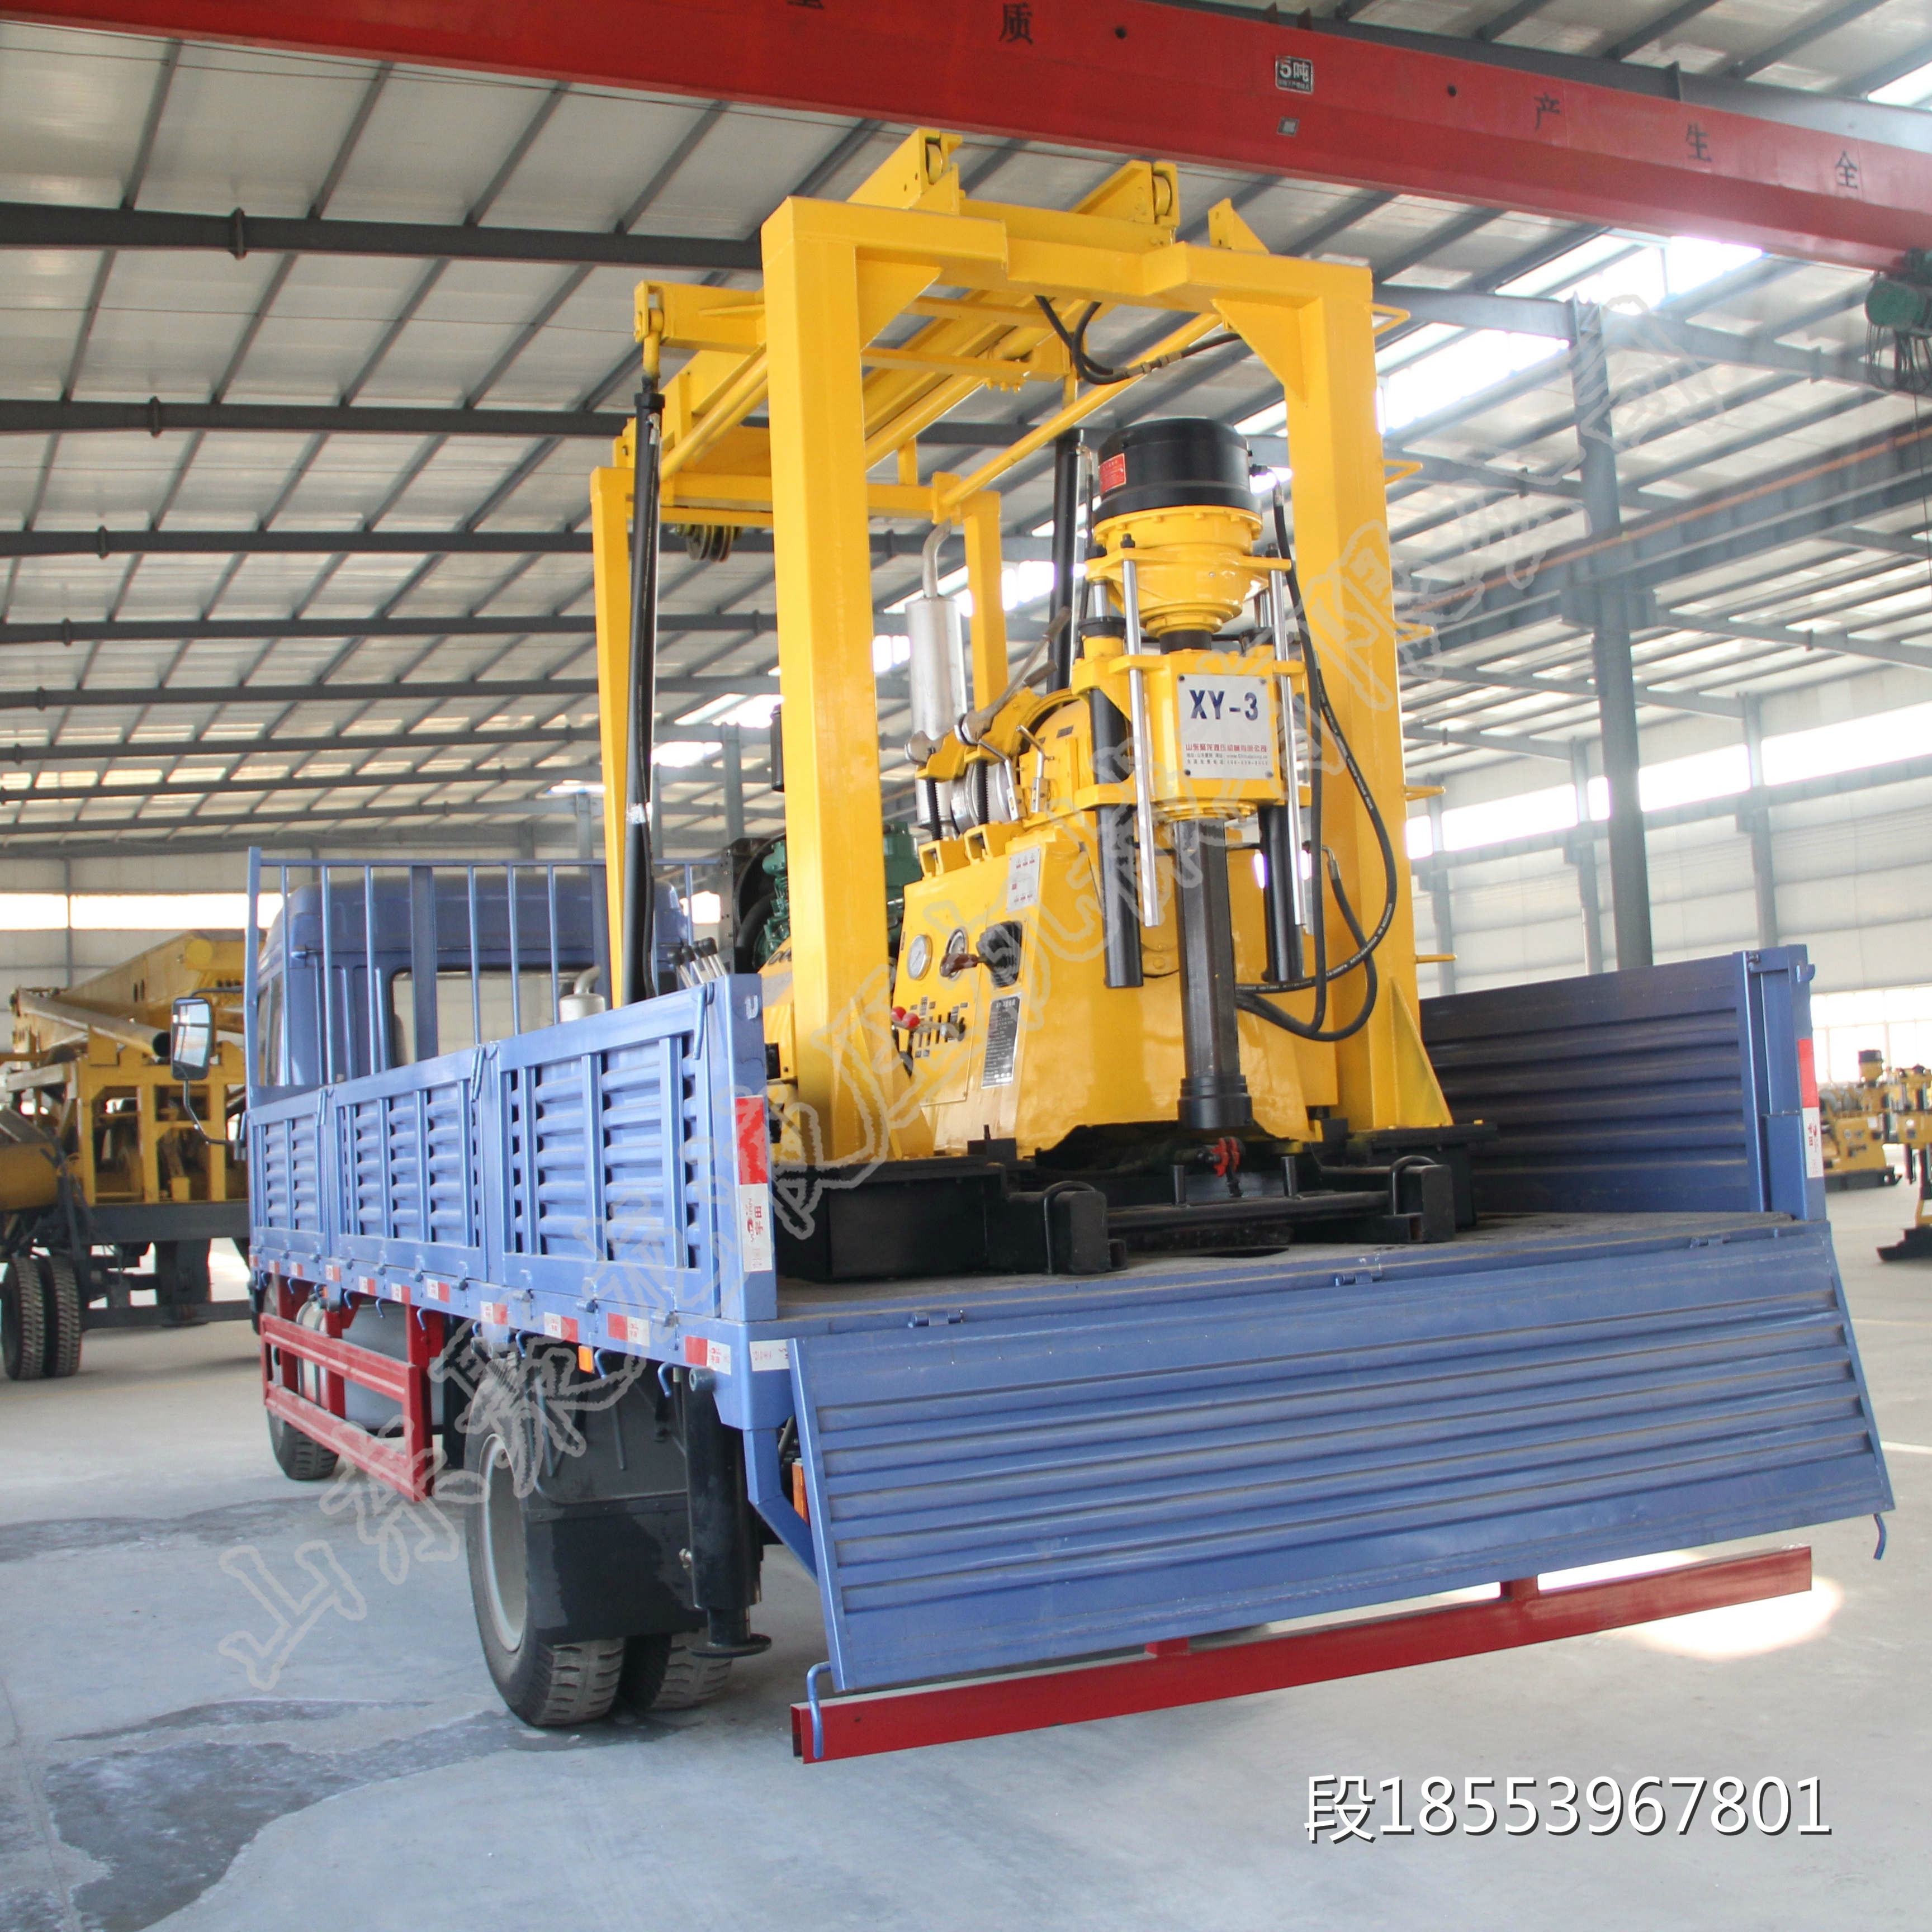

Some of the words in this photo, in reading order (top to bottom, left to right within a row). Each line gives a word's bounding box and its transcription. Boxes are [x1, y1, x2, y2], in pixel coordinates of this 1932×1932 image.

[998, 2, 1034, 45] 质
[1279, 60, 1310, 82] 5吨
[1534, 93, 1560, 130] 产
[1686, 124, 1712, 162] 生
[1835, 150, 1858, 190] 全
[1190, 690, 1258, 721] XY-3
